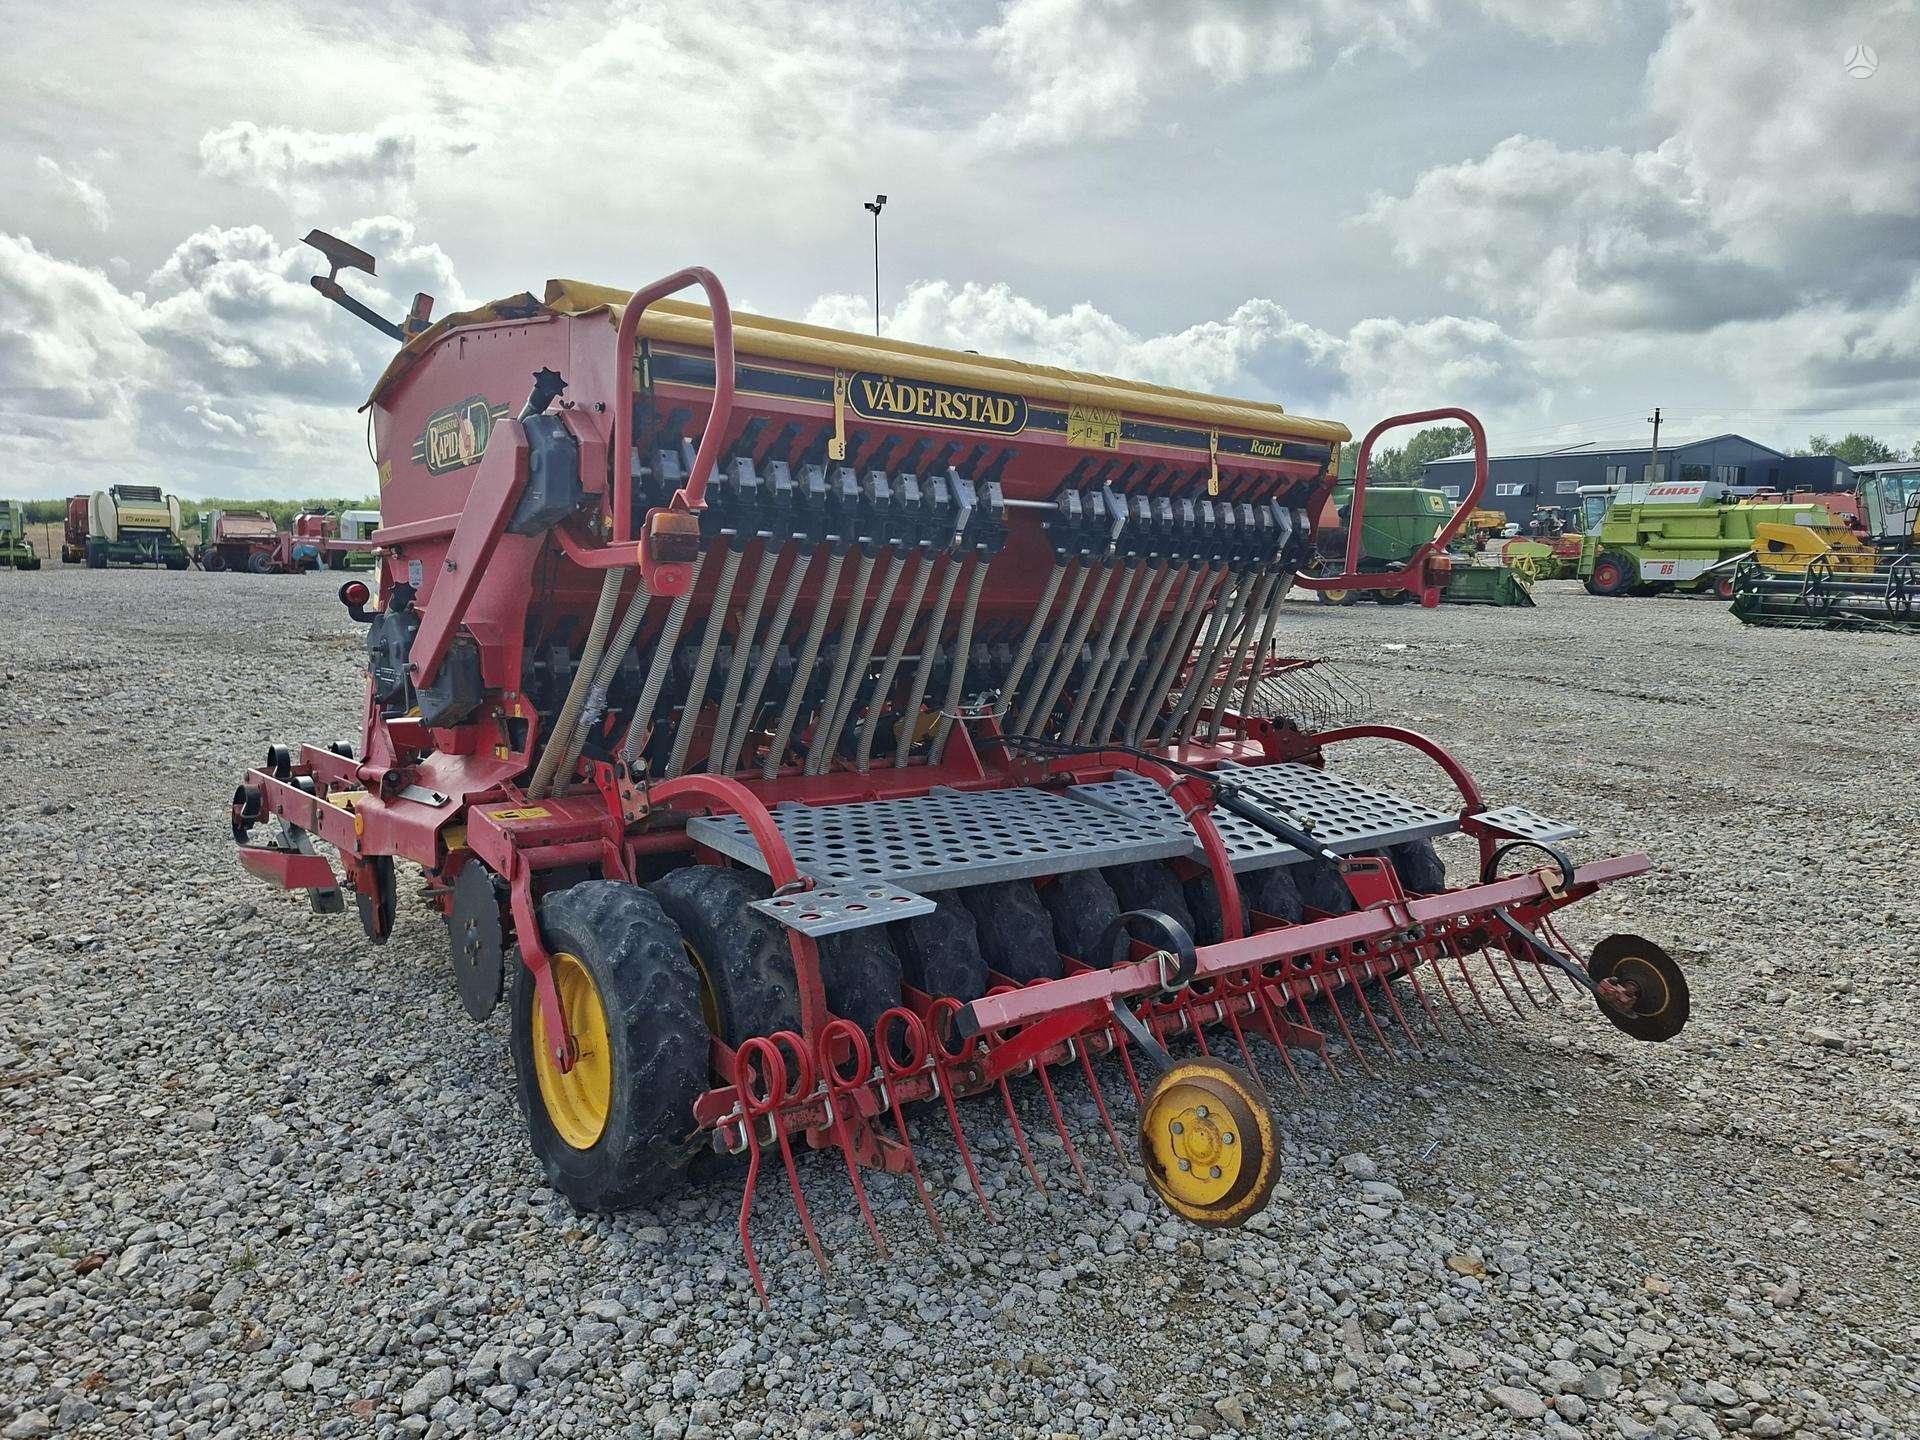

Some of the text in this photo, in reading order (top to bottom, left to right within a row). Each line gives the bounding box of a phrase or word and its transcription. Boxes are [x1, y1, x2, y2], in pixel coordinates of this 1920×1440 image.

[861, 375, 1016, 425] VÄDERSTAD
[1250, 439, 1283, 456] Rapid
[1648, 486, 1703, 496] CLAAS
[1660, 564, 1674, 575] 86
